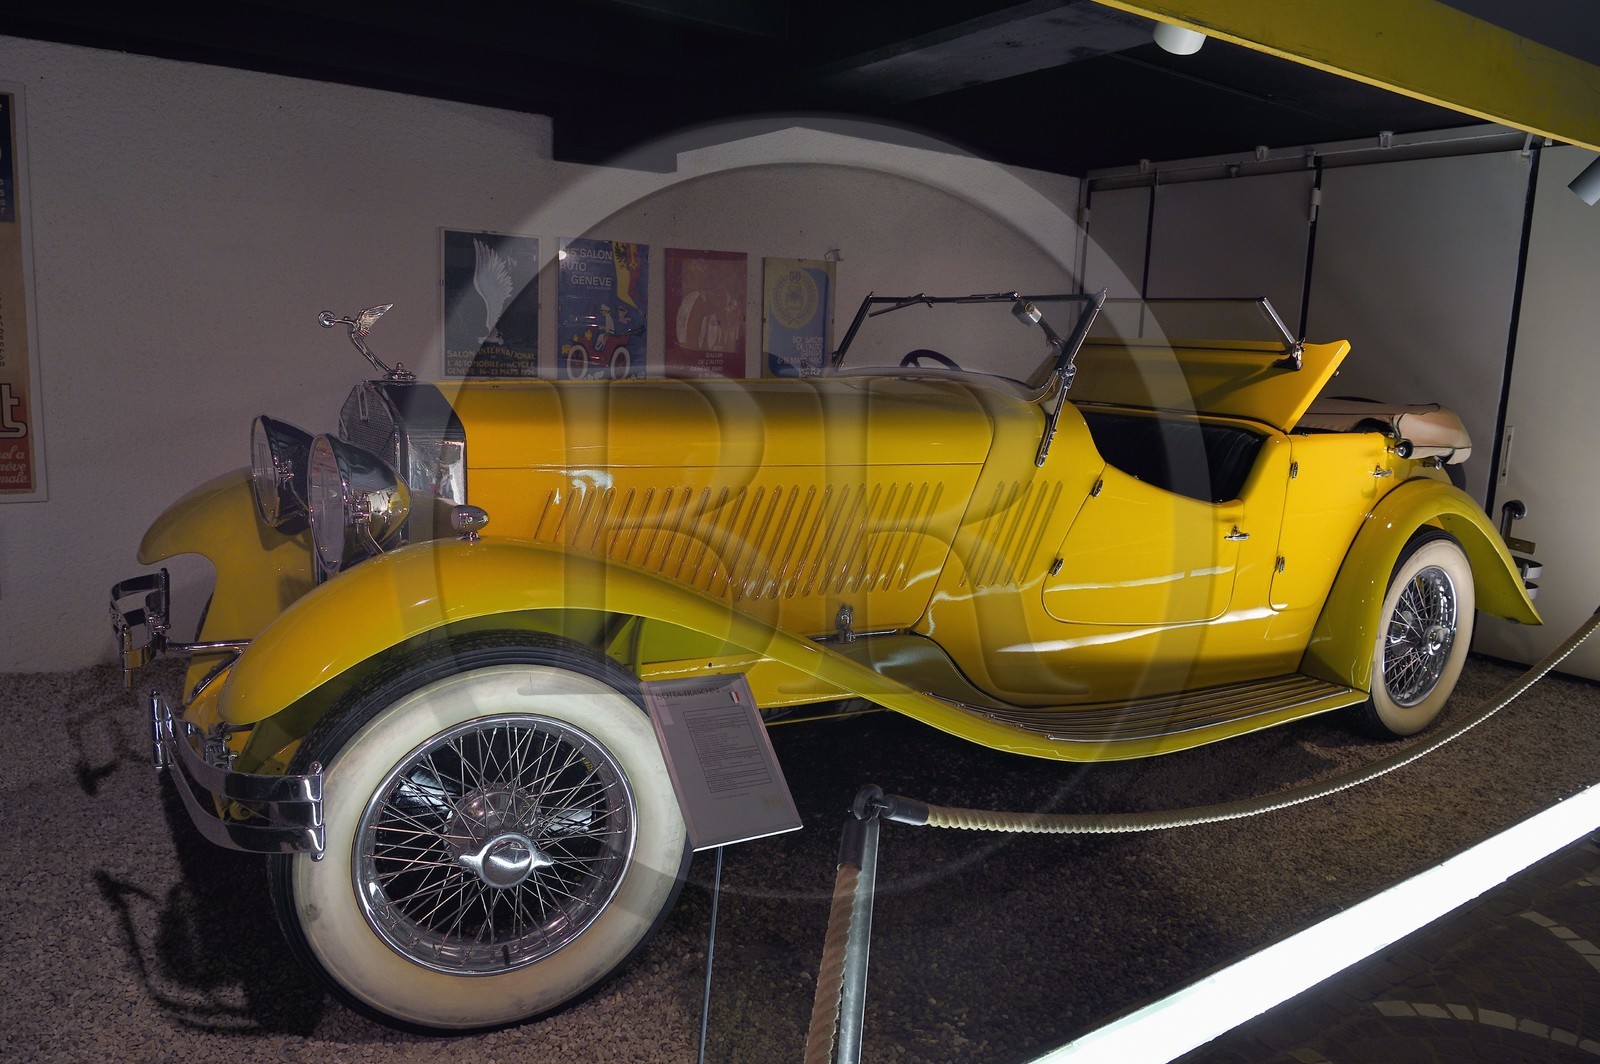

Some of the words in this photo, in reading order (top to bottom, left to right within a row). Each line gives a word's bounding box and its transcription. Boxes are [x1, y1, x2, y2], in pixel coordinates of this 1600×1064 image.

[580, 248, 612, 260] SALON
[560, 261, 586, 272] AUTO
[571, 275, 612, 287] GENEVE
[446, 349, 475, 358] SALON
[479, 346, 536, 360] INTERNATIONAL
